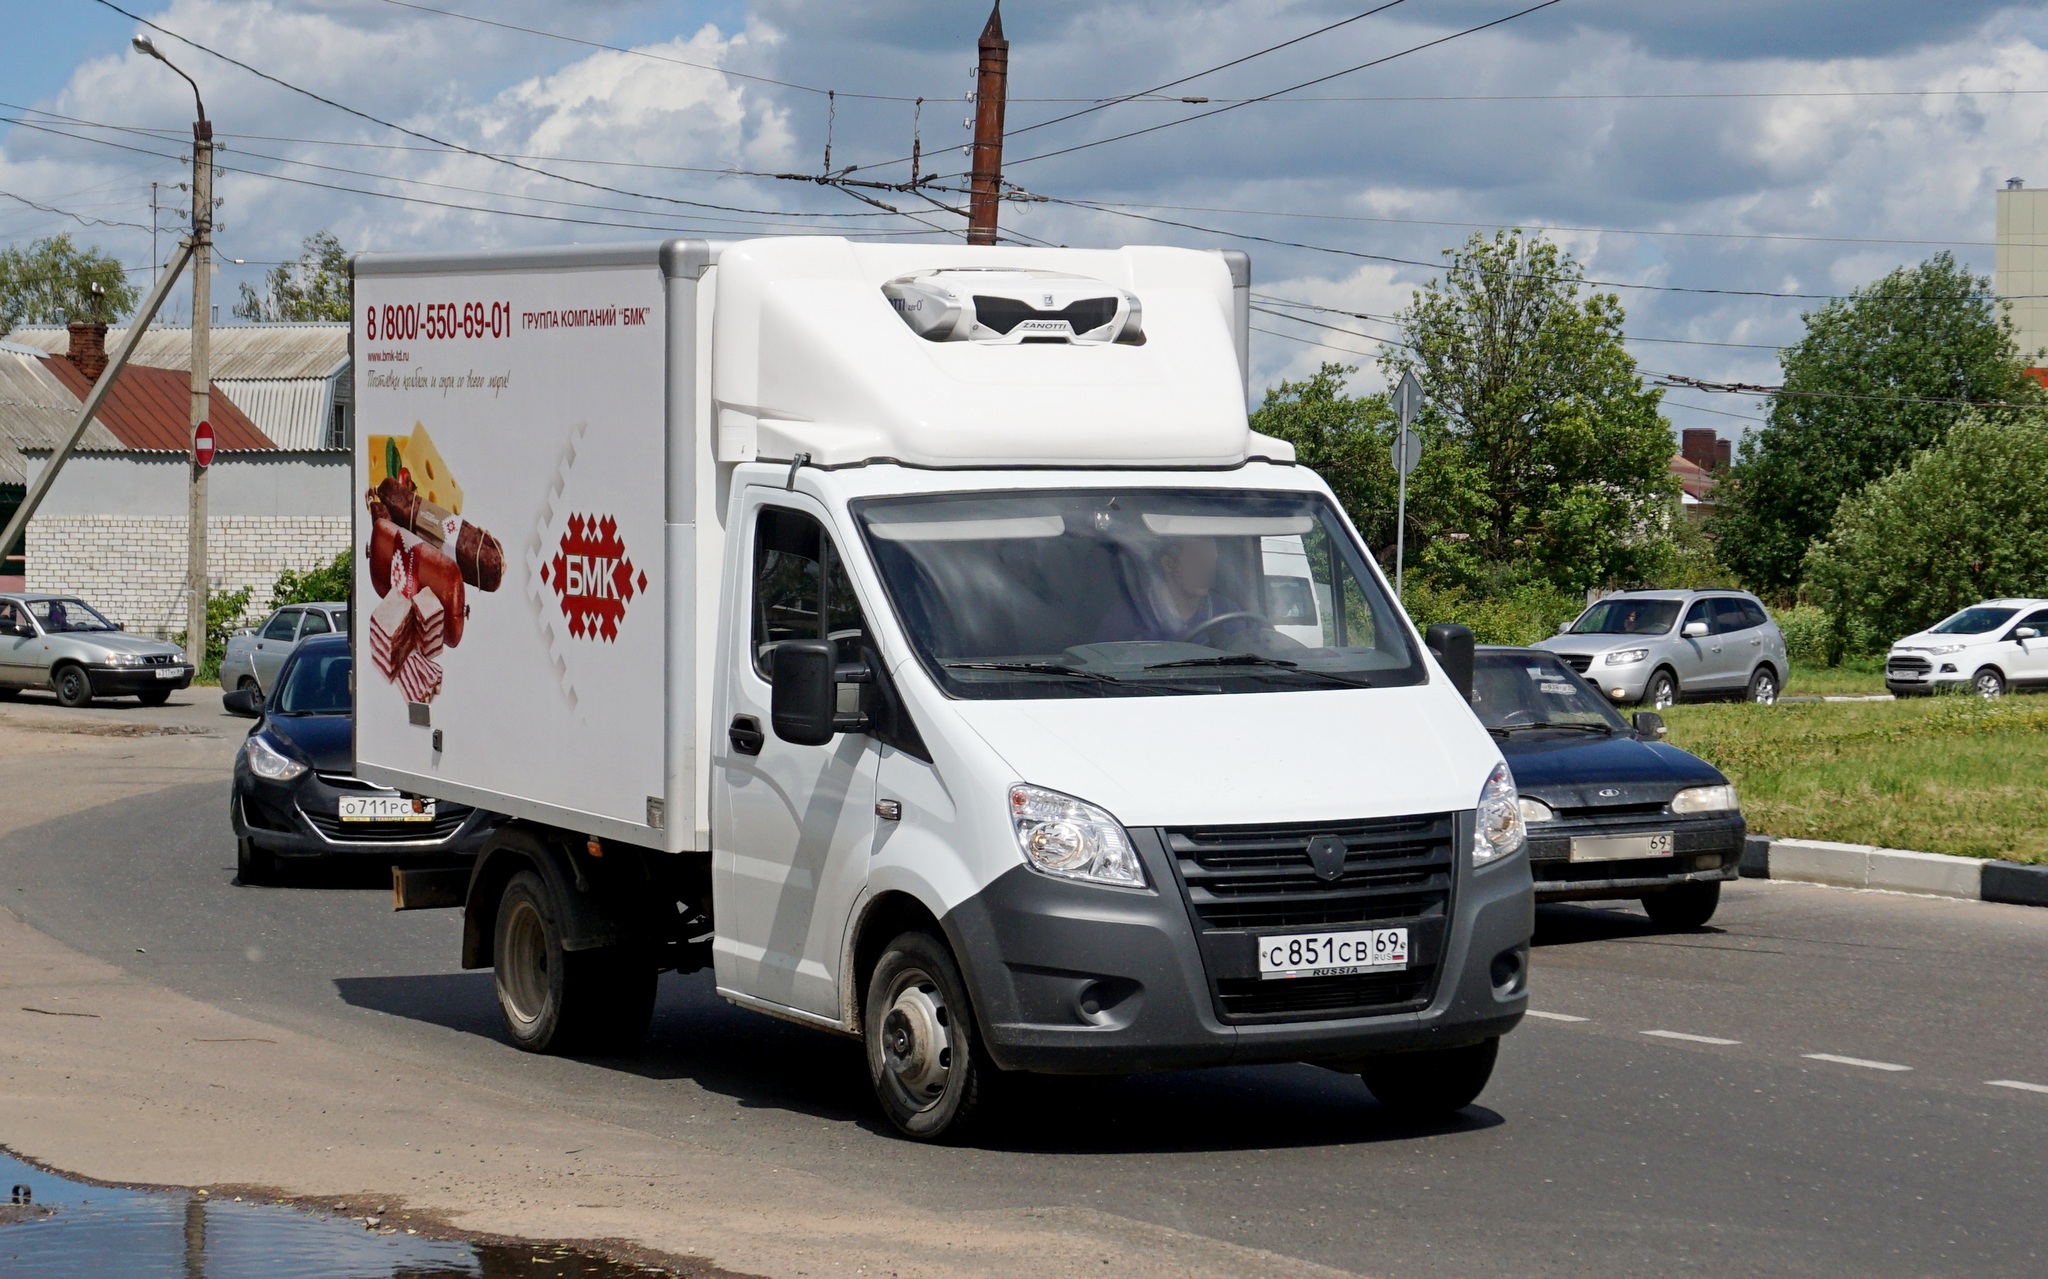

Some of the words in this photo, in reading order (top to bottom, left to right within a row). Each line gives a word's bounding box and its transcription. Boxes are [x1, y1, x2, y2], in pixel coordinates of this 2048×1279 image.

[380, 301, 510, 340] /800/-550-69-01
[522, 310, 559, 329] ГРУППА
[561, 303, 617, 328] КОМПАНИЙ
[1022, 321, 1067, 330] ZANOTTI
[367, 349, 409, 361] www.bmk-td.ru
[367, 369, 400, 390] Поставки
[430, 376, 436, 388] и
[456, 376, 465, 388] со
[467, 368, 484, 388] всего
[566, 554, 621, 600] БМК
[1650, 836, 1666, 849] 69
[1376, 932, 1399, 953] 69
[1374, 952, 1392, 961] RUS
[1313, 967, 1359, 976] RUSSIA
